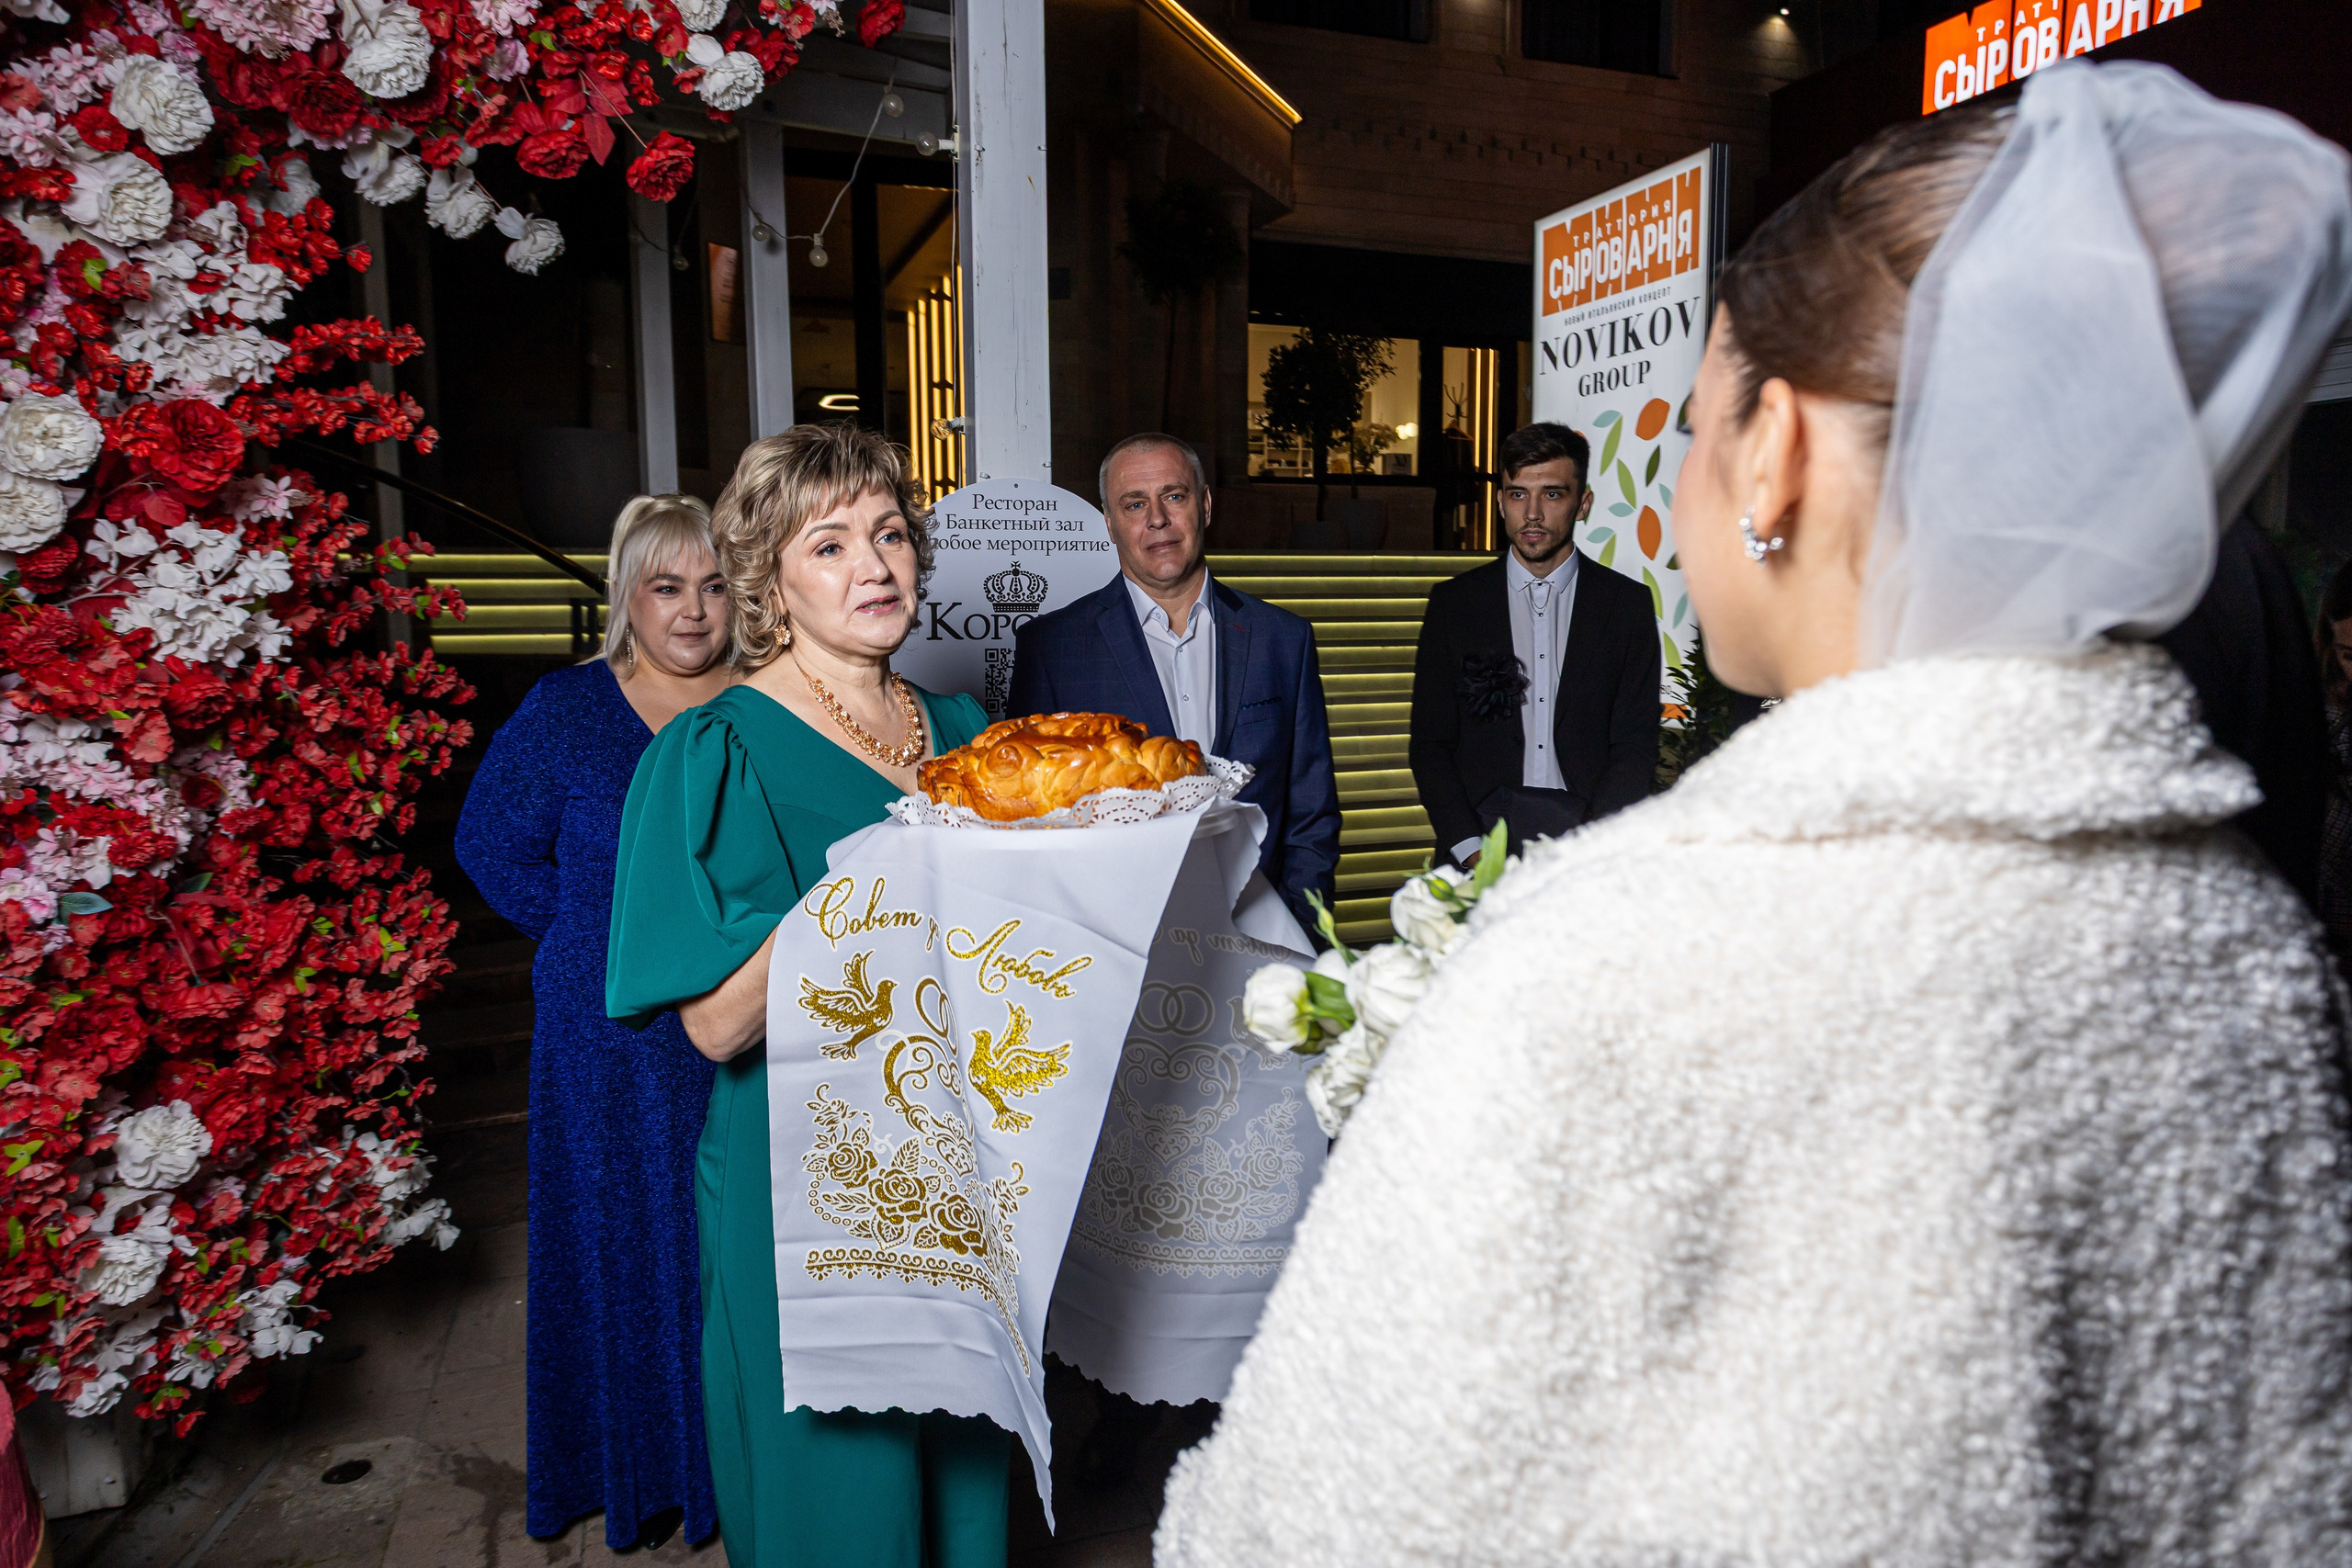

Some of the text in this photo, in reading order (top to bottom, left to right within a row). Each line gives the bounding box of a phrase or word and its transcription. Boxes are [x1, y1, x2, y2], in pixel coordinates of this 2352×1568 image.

[1573, 199, 1671, 248] ТРАТТОРИЯ
[1549, 209, 1693, 299] СЫРОВАРНЯ
[1539, 296, 1702, 376] NOVIKOV
[1578, 360, 1652, 397] GROUP
[946, 513, 1084, 532] Банкетный зал
[972, 493, 1058, 516] Ресторан
[987, 537, 1110, 556] мероприятие
[804, 876, 922, 951] Совет
[946, 919, 1092, 998] Любовь
